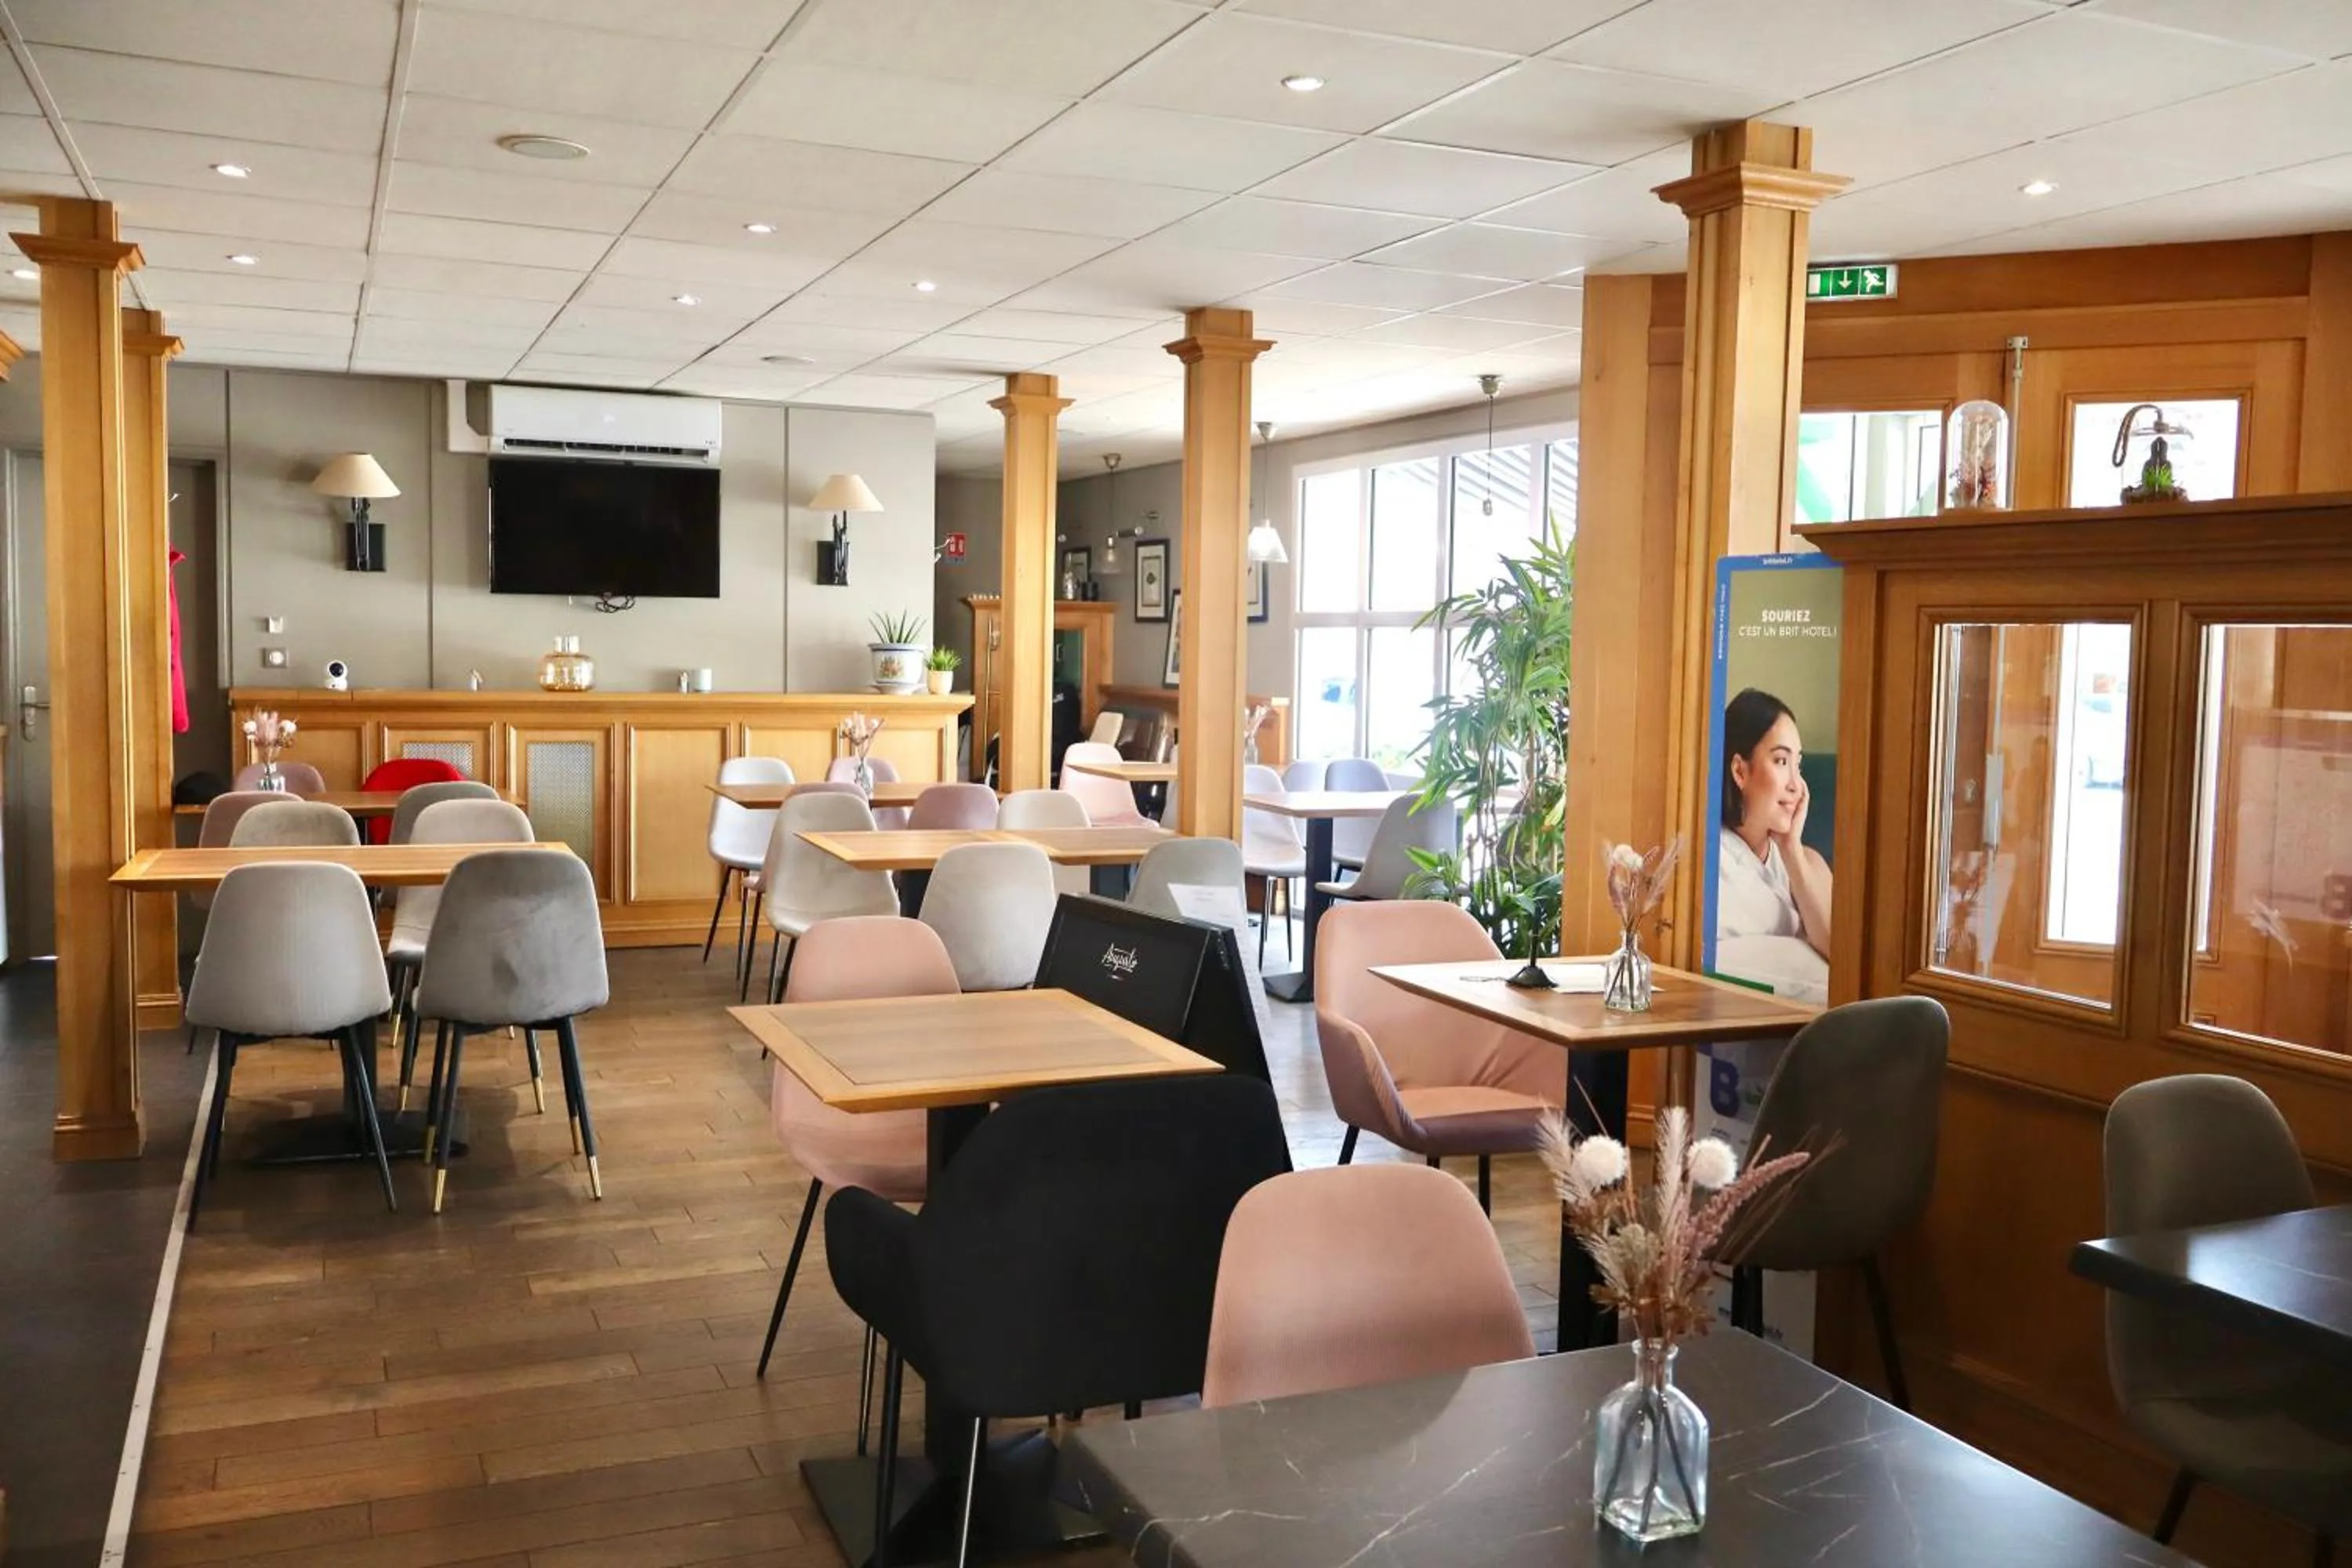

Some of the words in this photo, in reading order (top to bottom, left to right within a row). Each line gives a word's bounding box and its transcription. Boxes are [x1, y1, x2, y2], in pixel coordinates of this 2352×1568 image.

[1762, 609, 1811, 622] SOURIEZ
[1738, 625, 1762, 637] C'EST
[1762, 625, 1777, 637] UN
[1779, 626, 1799, 637] BRIT
